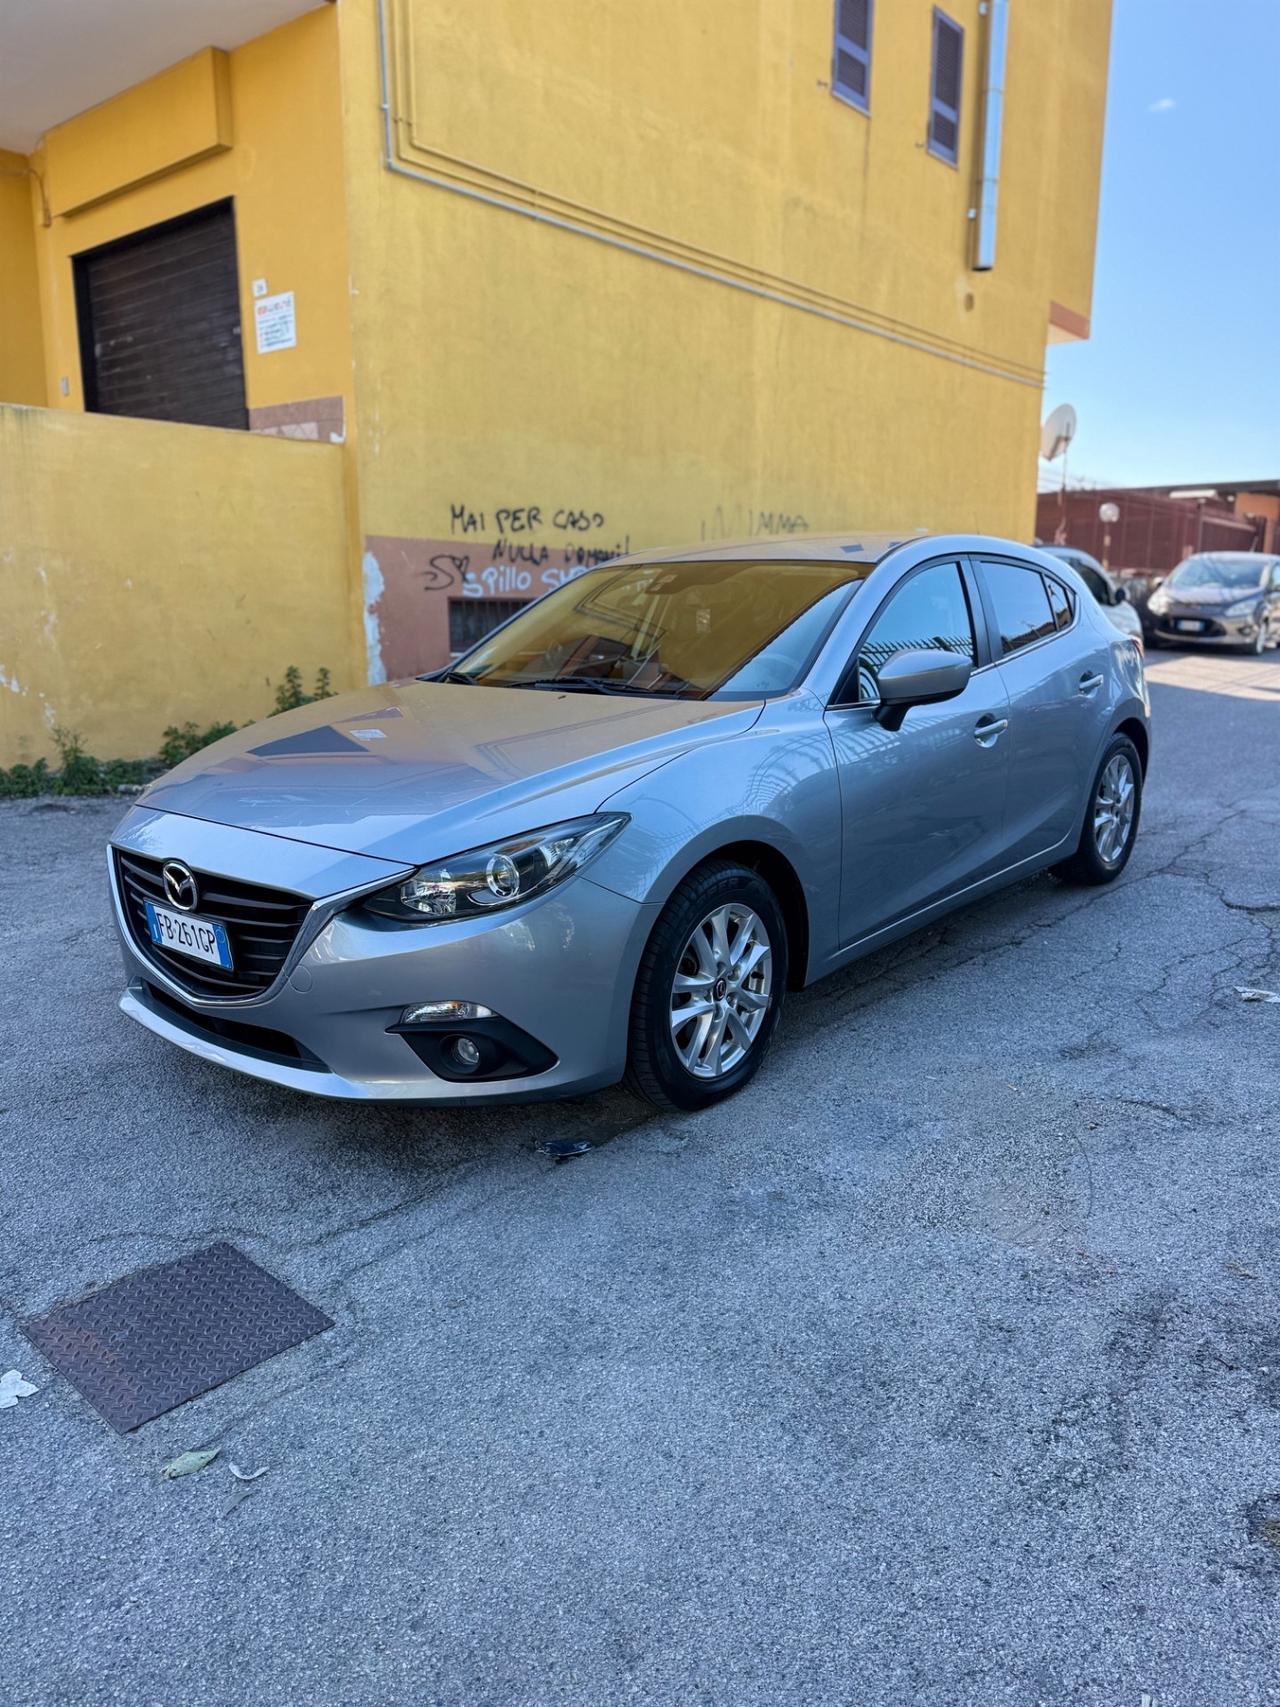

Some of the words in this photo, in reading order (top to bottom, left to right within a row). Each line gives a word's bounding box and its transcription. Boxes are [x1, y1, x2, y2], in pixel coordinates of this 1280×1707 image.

[450, 503, 485, 535] MAI
[495, 506, 543, 534] PER
[552, 509, 604, 531] CASO
[491, 538, 550, 567] NULLA
